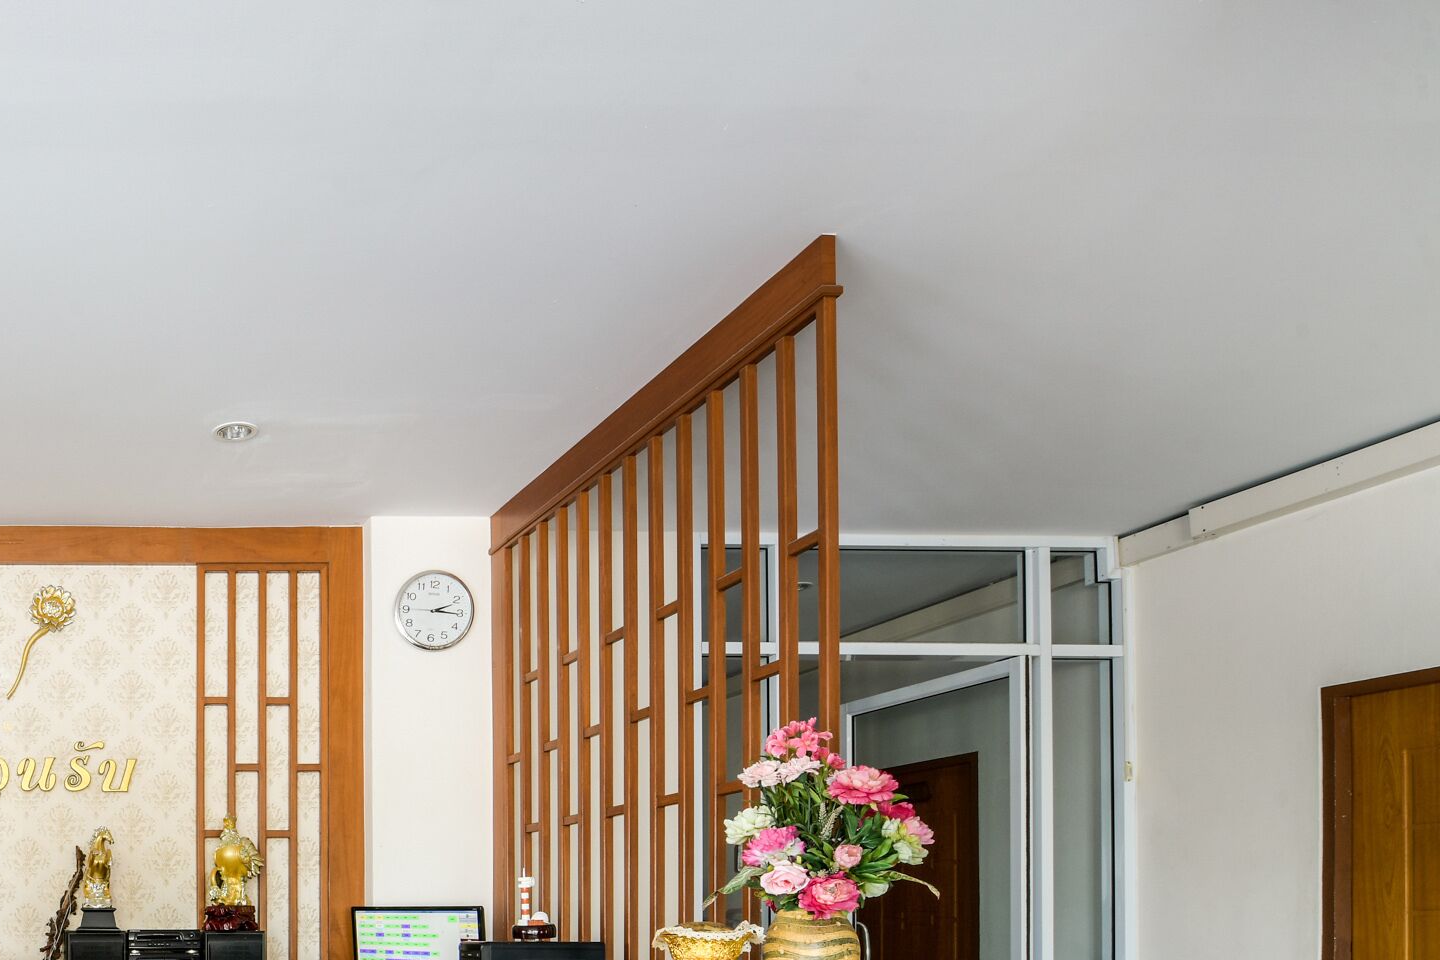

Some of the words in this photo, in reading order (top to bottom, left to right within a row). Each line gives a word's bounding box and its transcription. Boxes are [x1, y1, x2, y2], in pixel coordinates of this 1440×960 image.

[418, 582, 425, 590] 11
[430, 580, 440, 589] 12
[407, 592, 417, 600] 10
[453, 595, 461, 604] 2
[402, 605, 410, 613] 9
[456, 609, 464, 618] 3
[405, 619, 413, 627] 8
[451, 622, 458, 630] 4
[415, 629, 421, 638] 7
[440, 631, 448, 639] 5
[427, 634, 435, 642] 6
